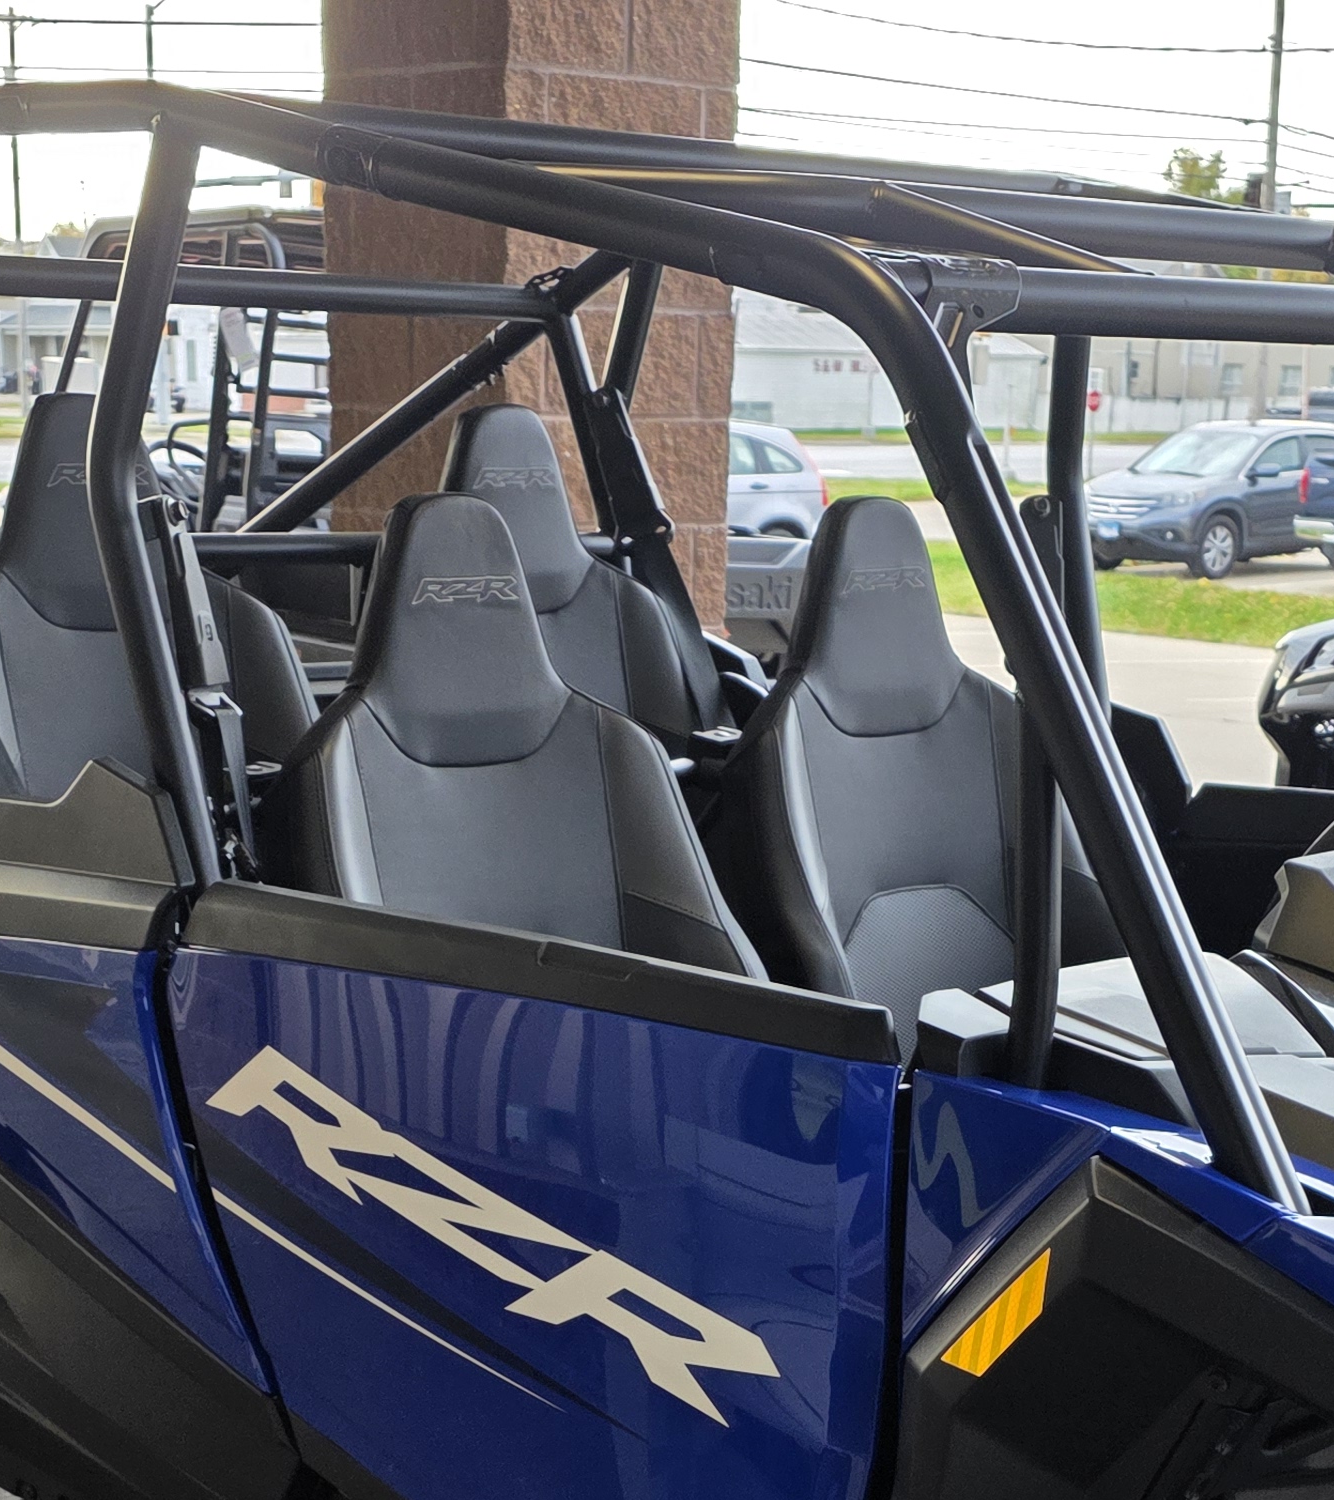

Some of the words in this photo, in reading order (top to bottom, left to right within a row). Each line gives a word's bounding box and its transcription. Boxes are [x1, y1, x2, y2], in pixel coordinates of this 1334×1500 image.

[472, 466, 556, 490] RZR
[412, 575, 520, 605] RZR
[727, 575, 793, 611] saki
[840, 565, 926, 597] RZR
[205, 1044, 781, 1429] RZR
